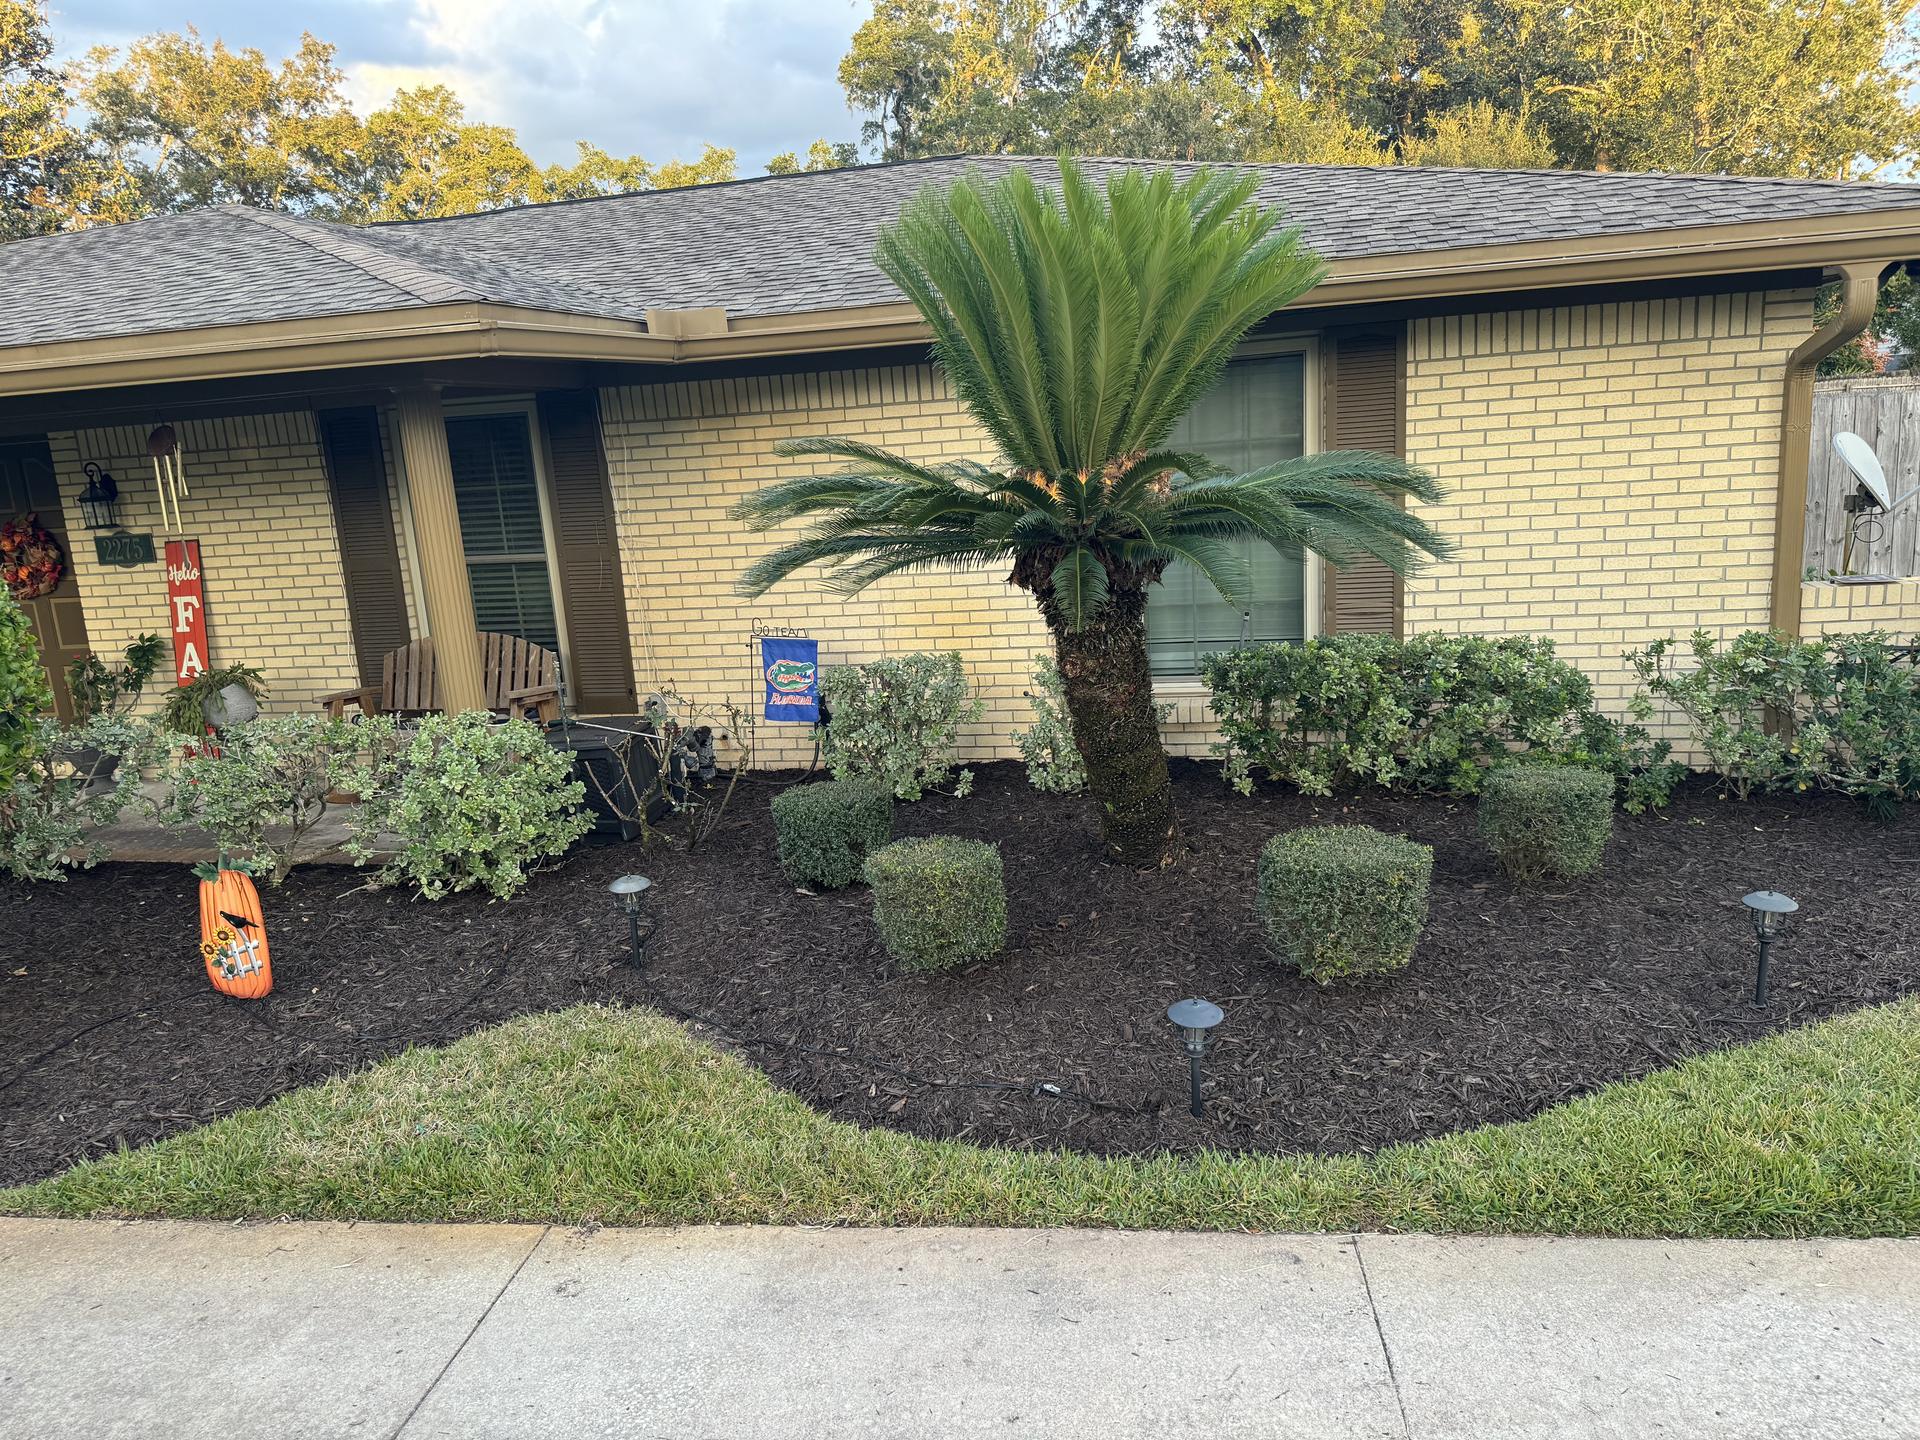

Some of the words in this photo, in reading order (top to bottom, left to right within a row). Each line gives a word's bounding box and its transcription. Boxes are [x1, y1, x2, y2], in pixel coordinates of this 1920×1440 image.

[103, 538, 144, 561] 2275
[168, 561, 201, 586] Hello
[173, 595, 207, 679] FA
[774, 627, 808, 638] TEAM
